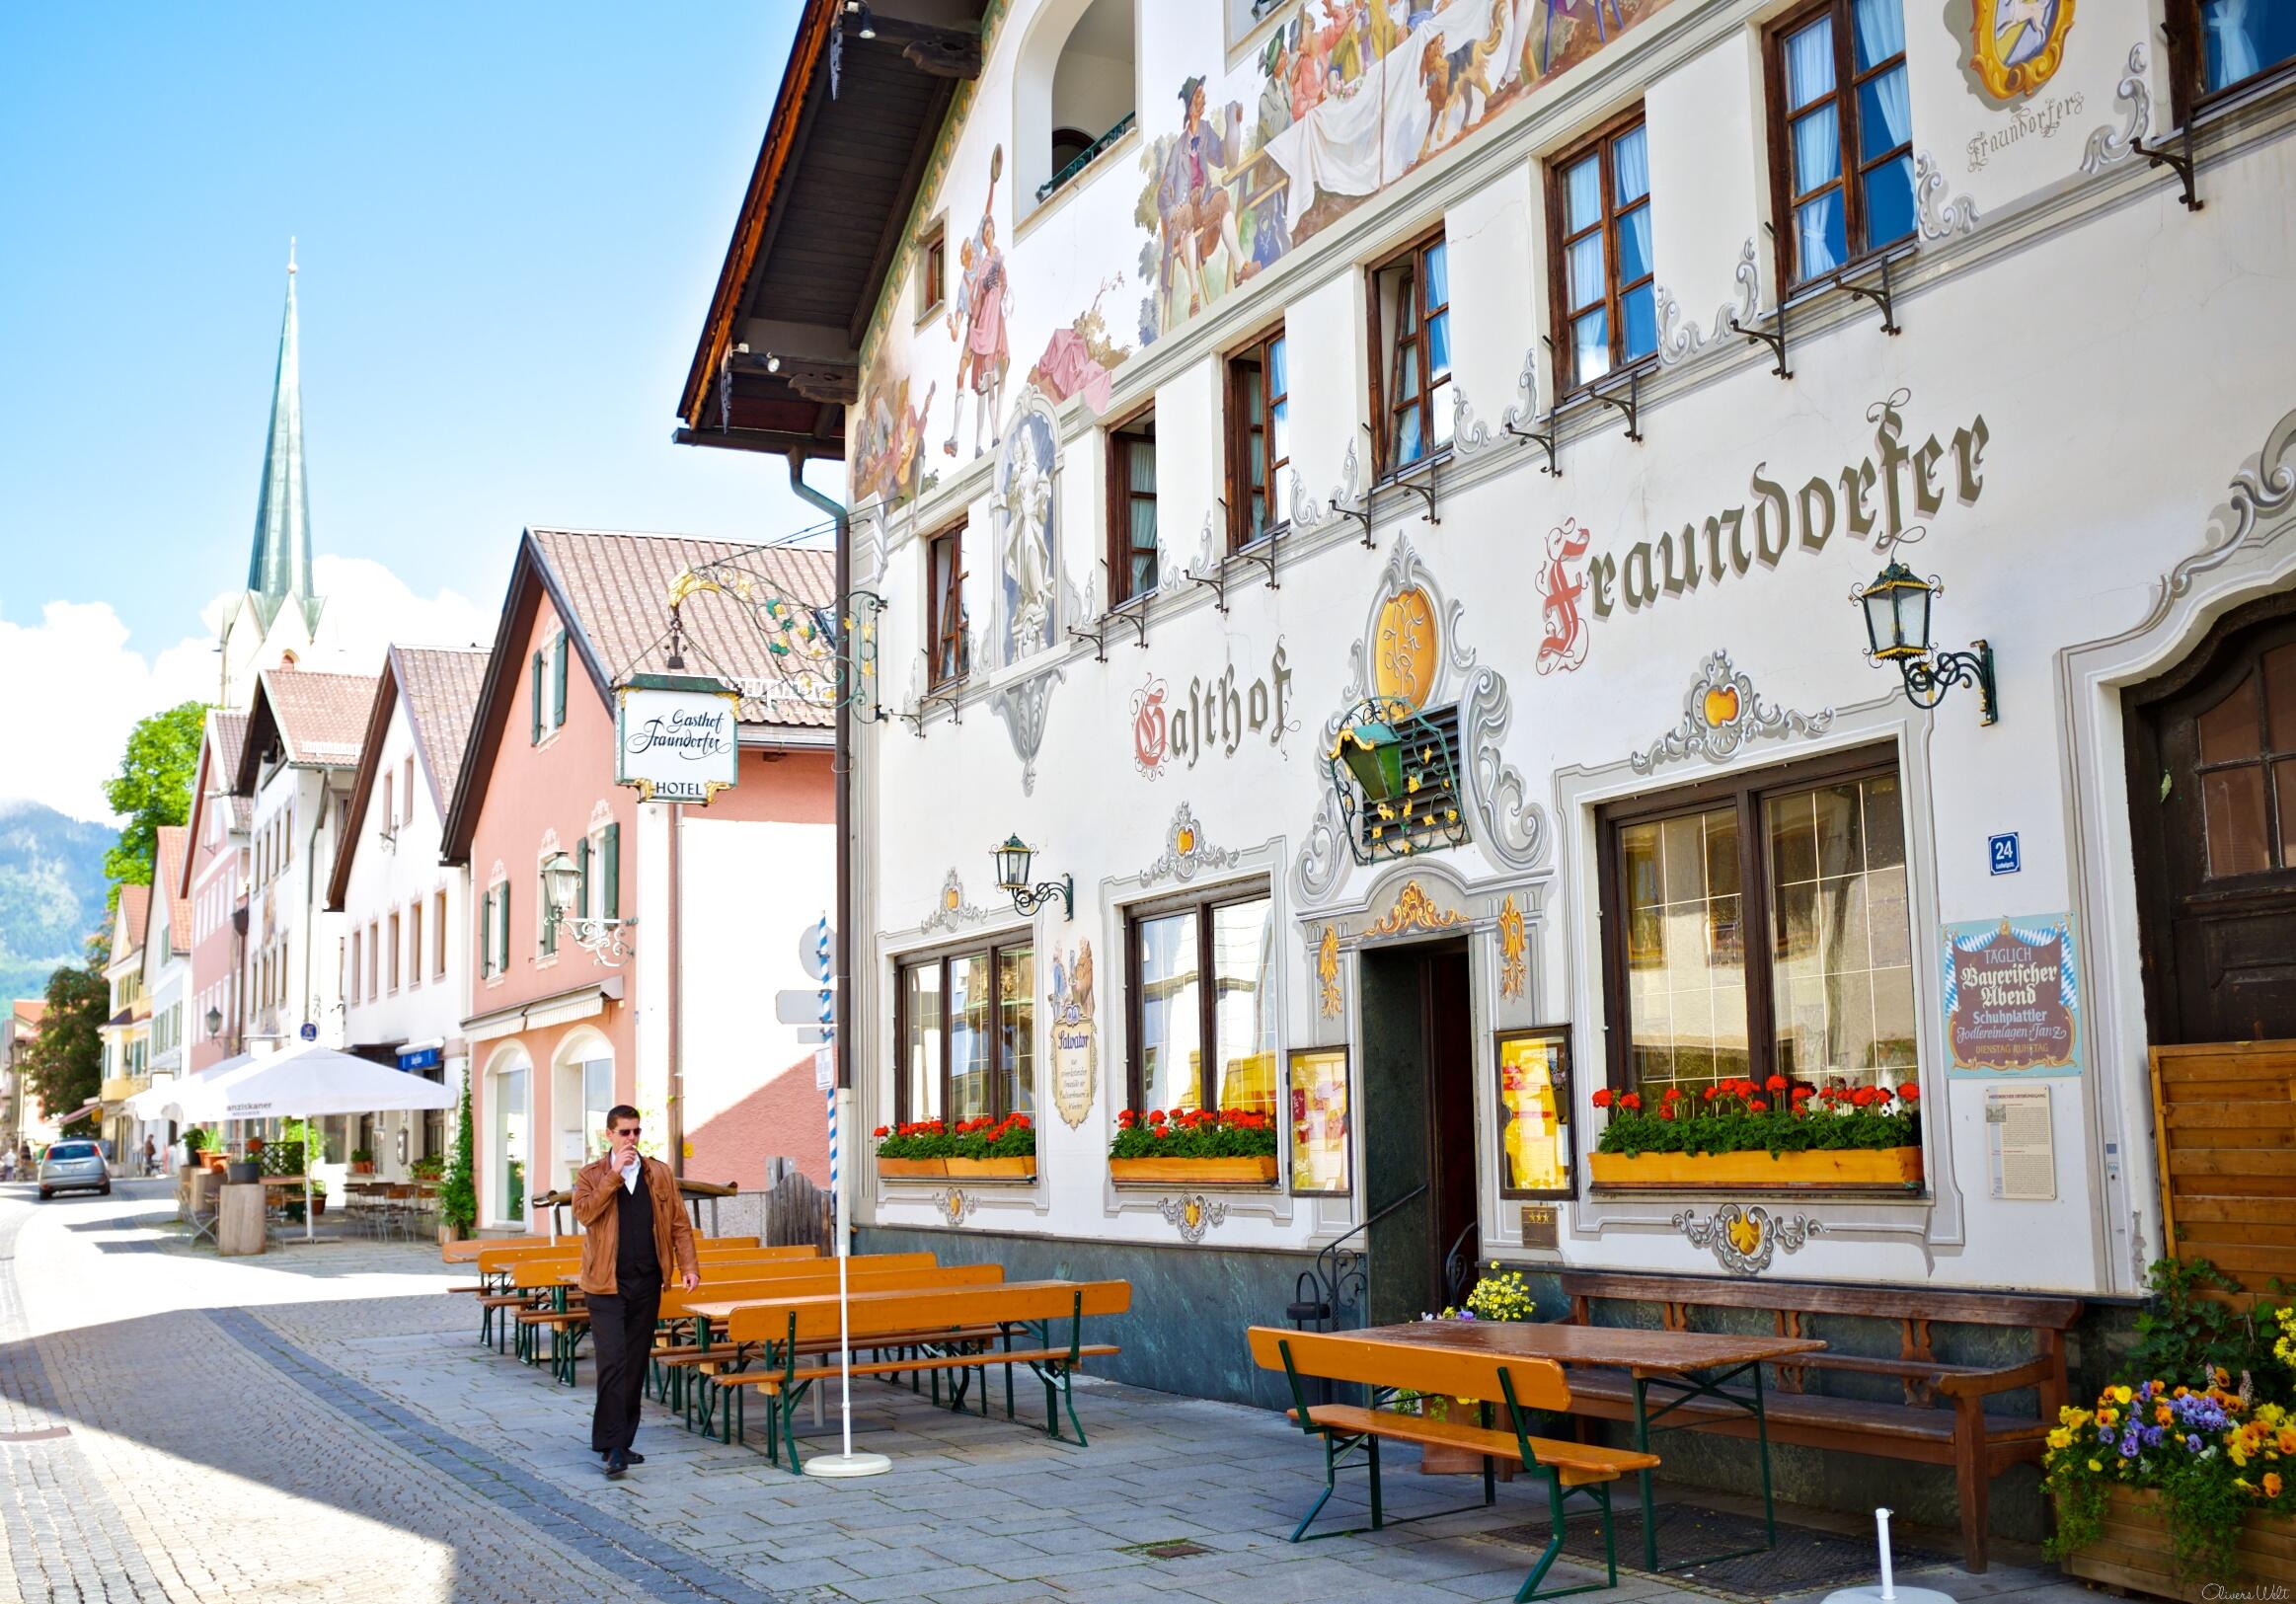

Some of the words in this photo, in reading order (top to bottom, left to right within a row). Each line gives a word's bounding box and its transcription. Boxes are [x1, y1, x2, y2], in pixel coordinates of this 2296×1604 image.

[1536, 388, 1990, 676] Fraundorfer
[666, 709, 725, 734] Gasthof
[626, 717, 731, 760] Fraundorfer
[655, 782, 702, 796] HOTEL
[1995, 840, 2014, 860] 24
[1980, 983, 2036, 1009] Abend
[1972, 1009, 2048, 1027] Schuhplattler
[1058, 1030, 1090, 1050] Salvator
[226, 1103, 272, 1111] anziskaner
